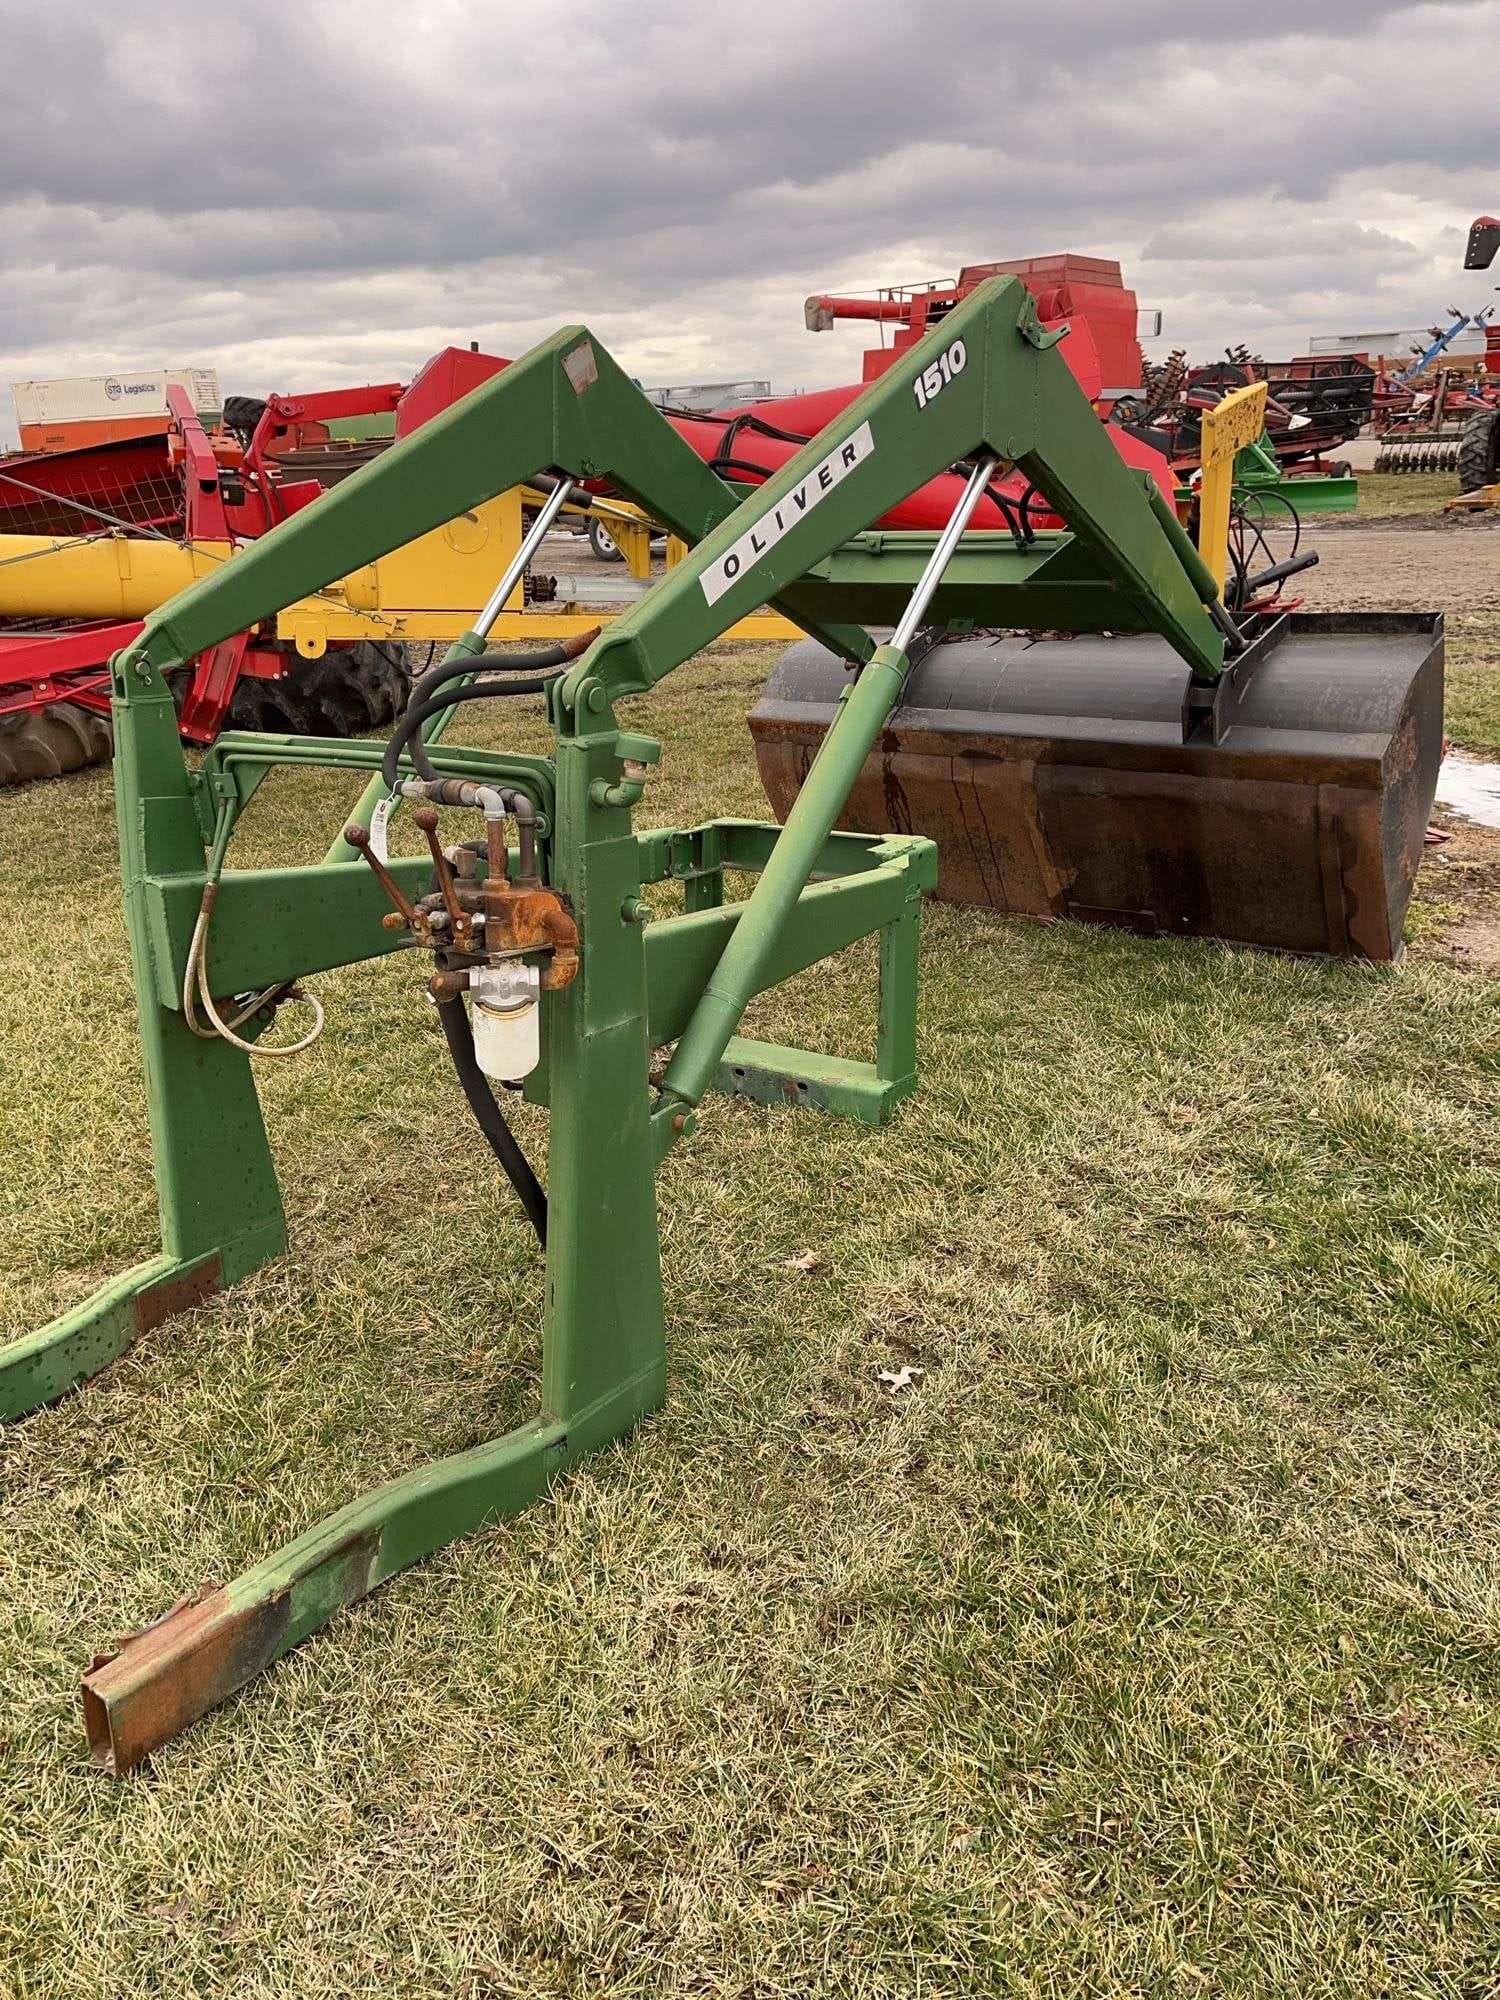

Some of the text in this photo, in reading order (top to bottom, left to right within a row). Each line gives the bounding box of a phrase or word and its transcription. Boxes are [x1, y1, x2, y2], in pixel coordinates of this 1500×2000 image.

[123, 383, 157, 395] Logistics
[912, 338, 968, 410] 1510
[723, 442, 857, 579] OLIVER
